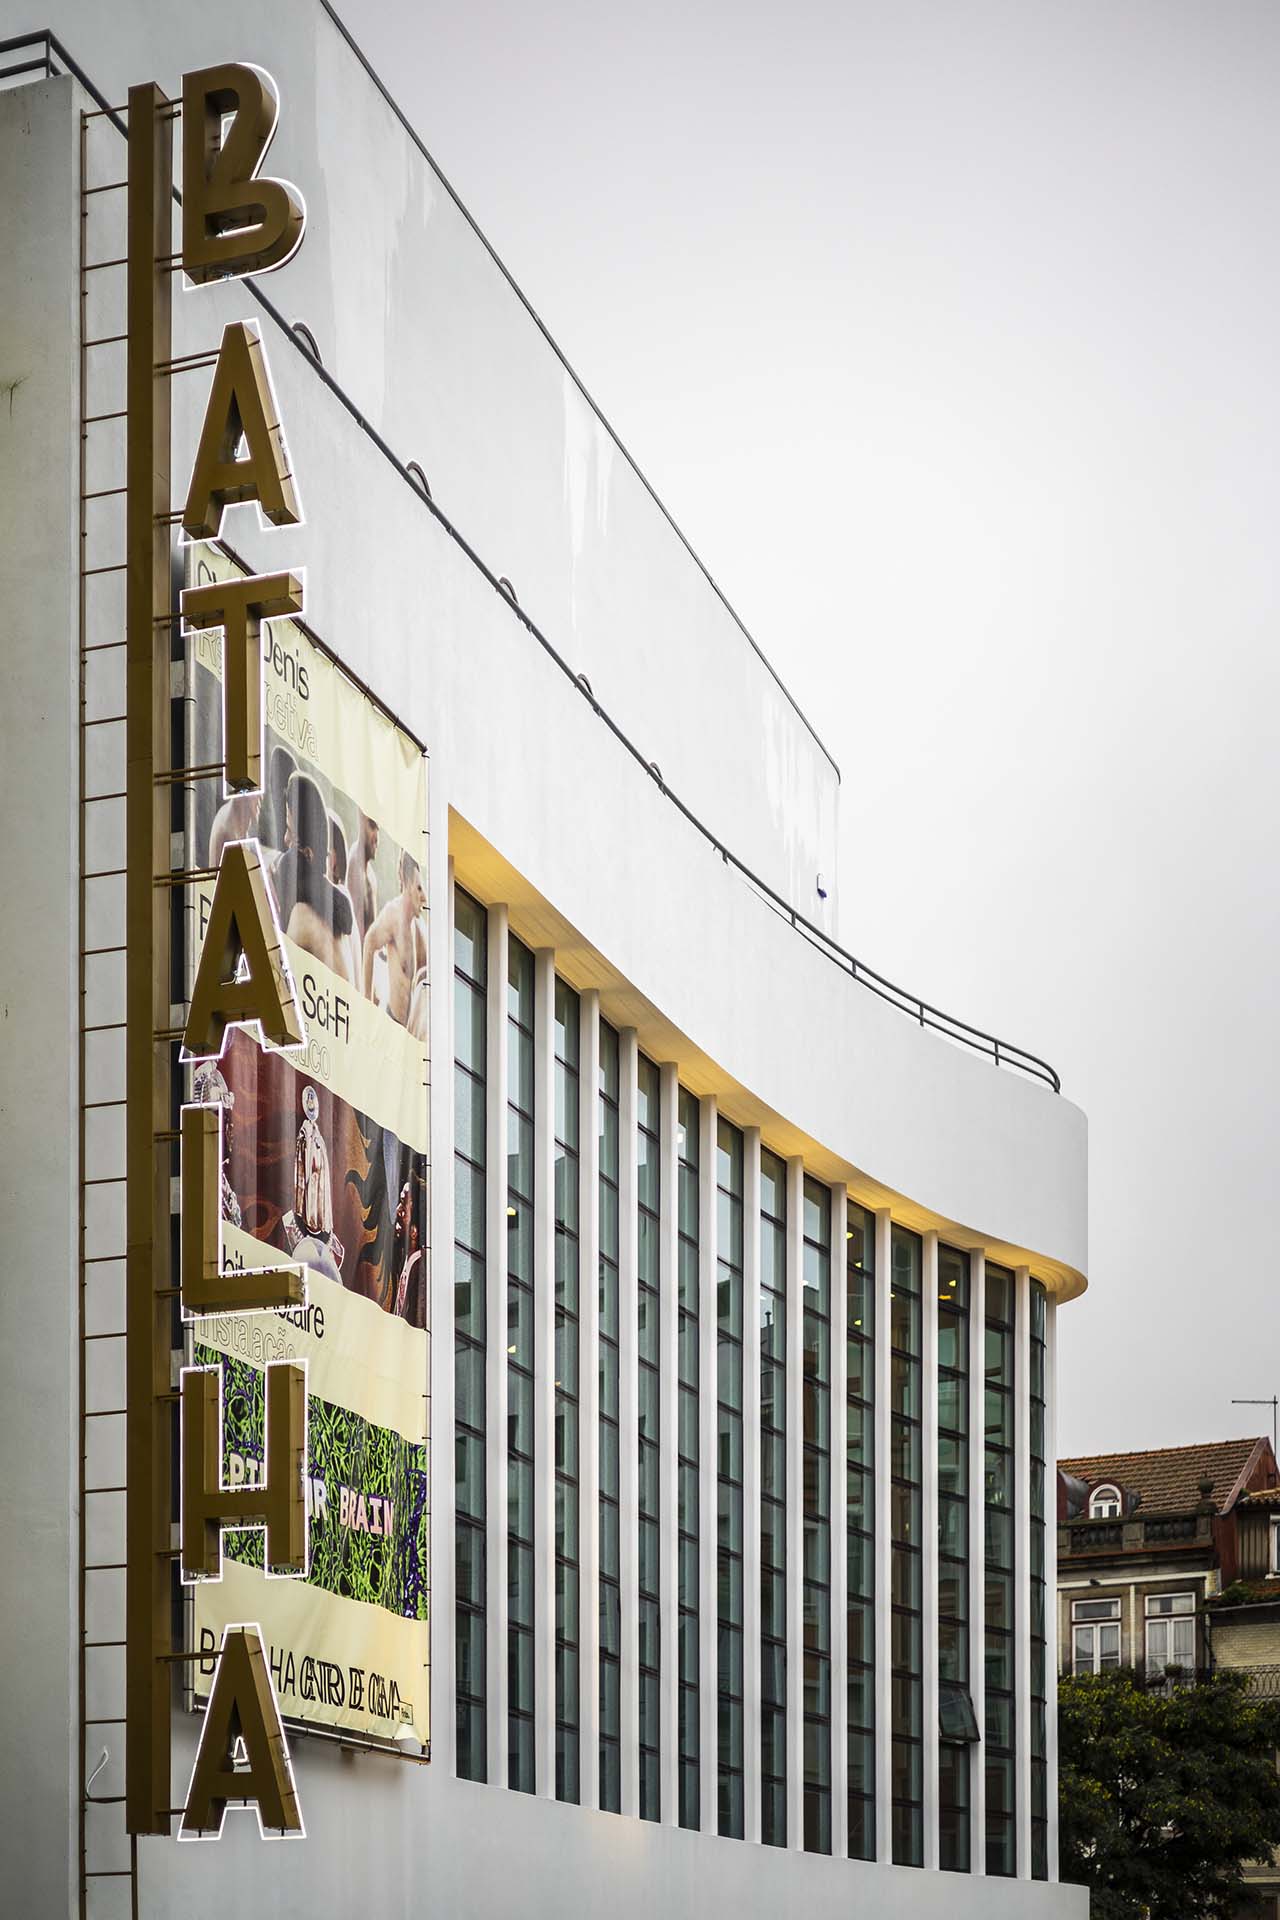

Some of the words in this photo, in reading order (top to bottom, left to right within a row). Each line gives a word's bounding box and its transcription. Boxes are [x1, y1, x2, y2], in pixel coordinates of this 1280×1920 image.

[263, 621, 309, 701] Denis
[178, 62, 308, 1841] BATALHA
[302, 974, 350, 1045] Sci-Fi
[339, 1485, 395, 1537] BRAIN
